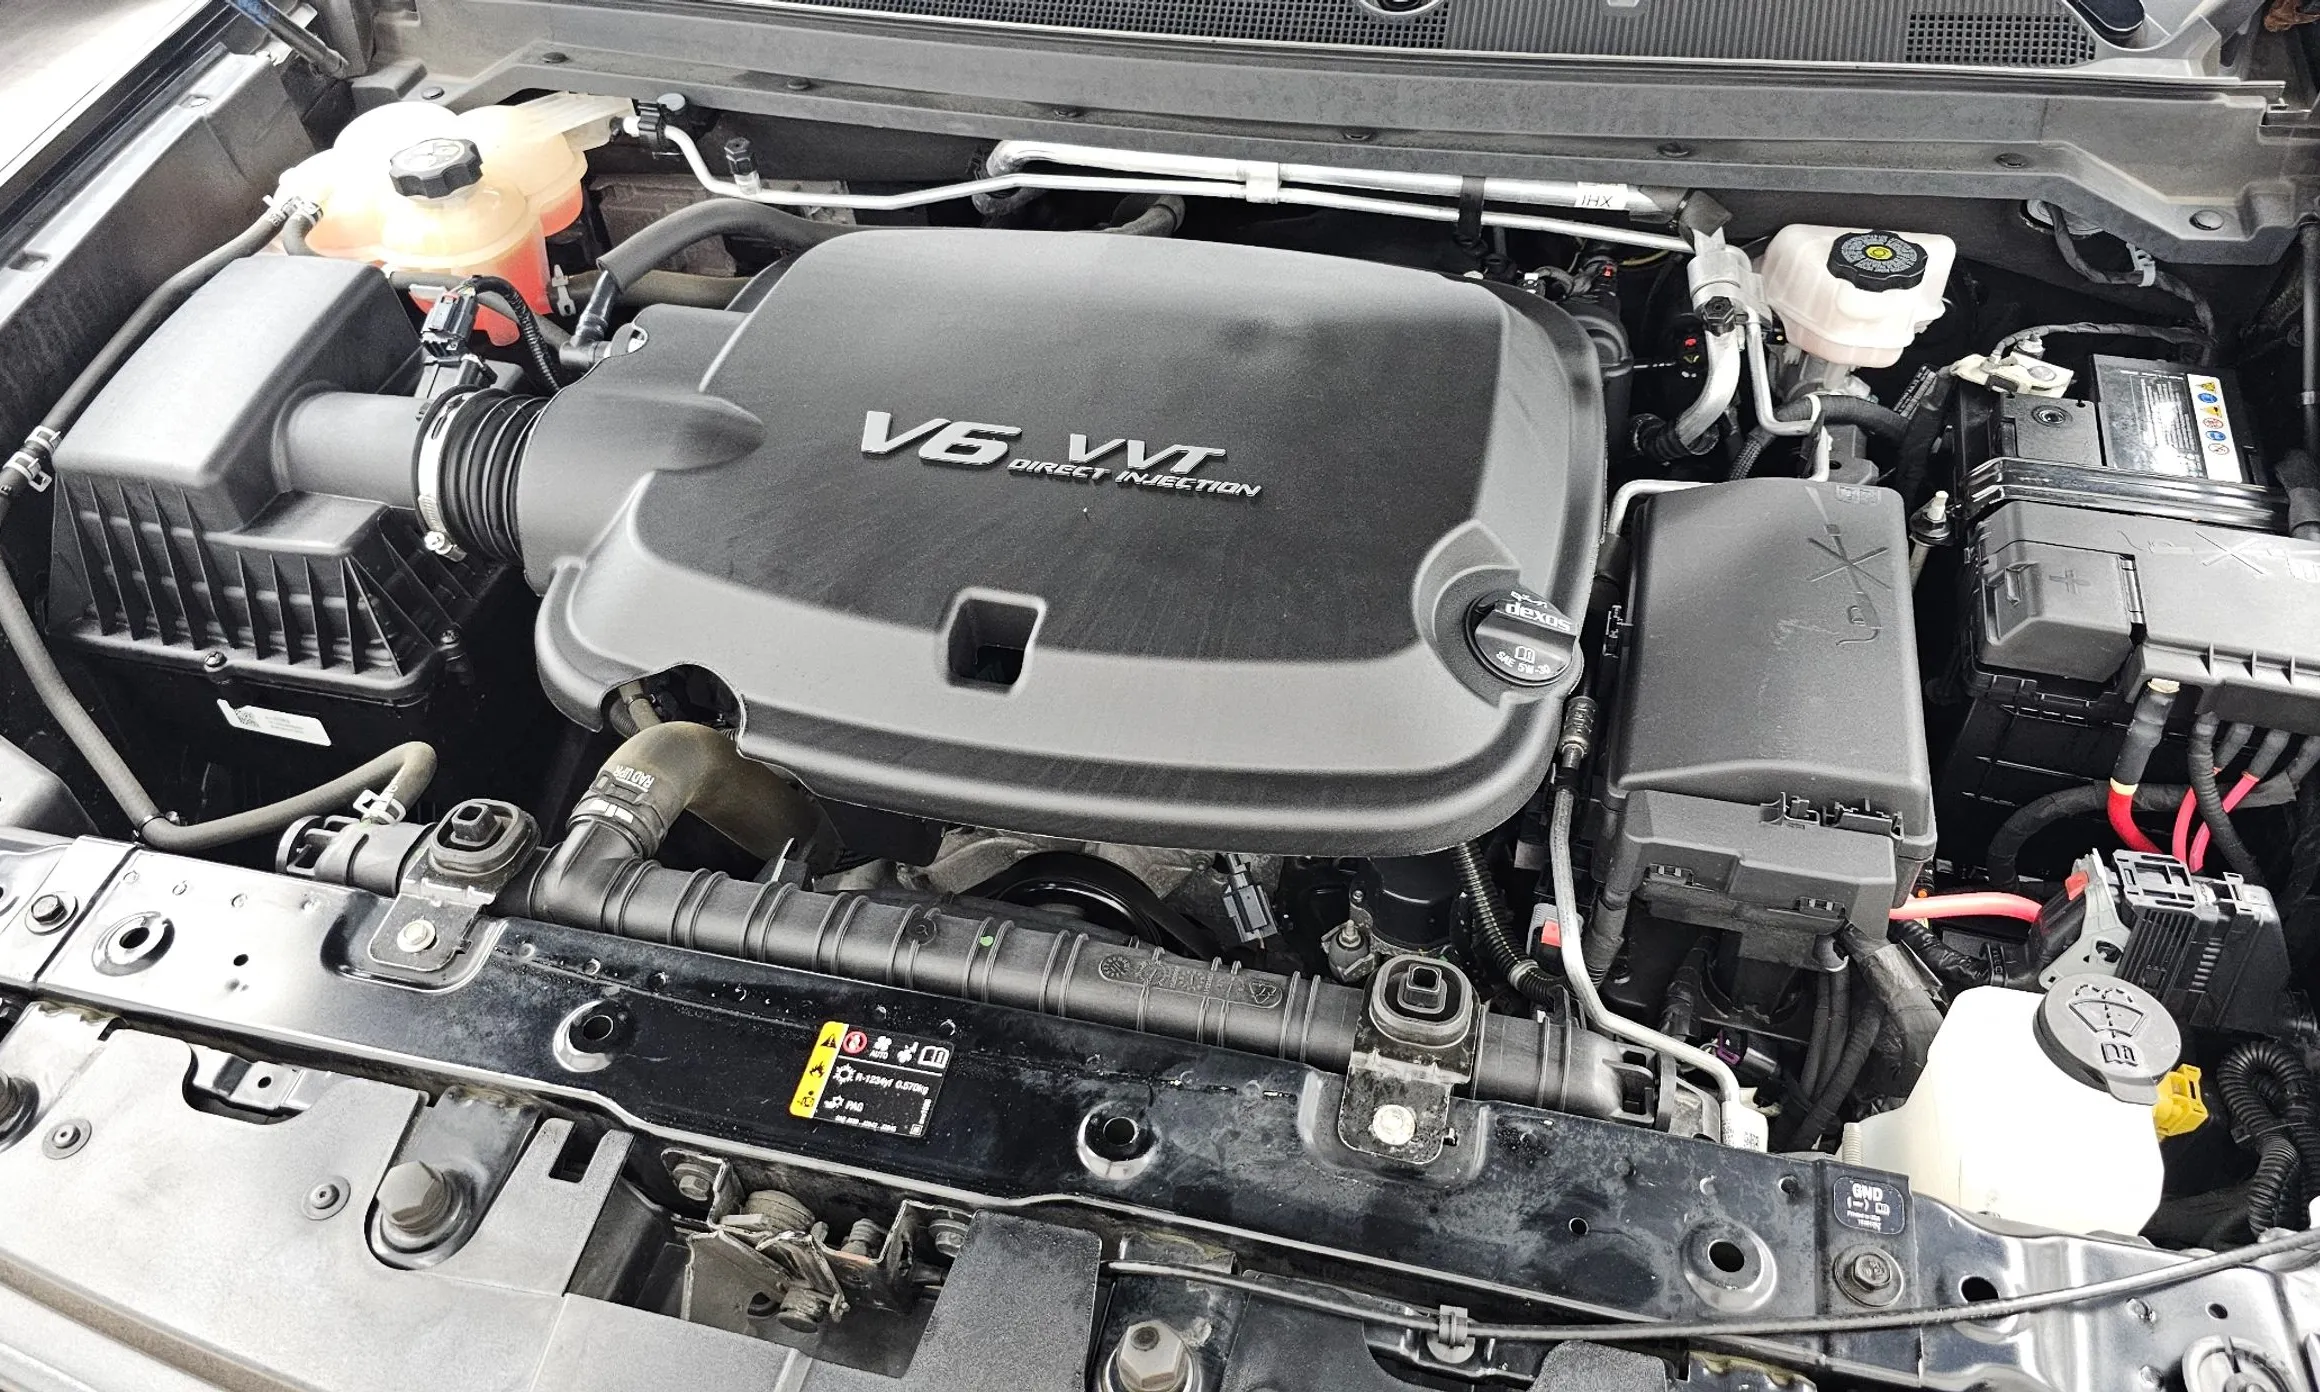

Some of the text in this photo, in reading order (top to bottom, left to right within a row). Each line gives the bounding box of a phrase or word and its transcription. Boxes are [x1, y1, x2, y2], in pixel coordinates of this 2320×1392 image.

[861, 410, 1226, 475] V6 VVT
[1007, 457, 1262, 498] DIRECT INJECTION
[1505, 602, 1571, 631] dexos
[1496, 651, 1516, 668] SAE
[631, 770, 655, 788] RAD
[844, 1099, 865, 1113] PAG
[1852, 1182, 1883, 1202] GND
